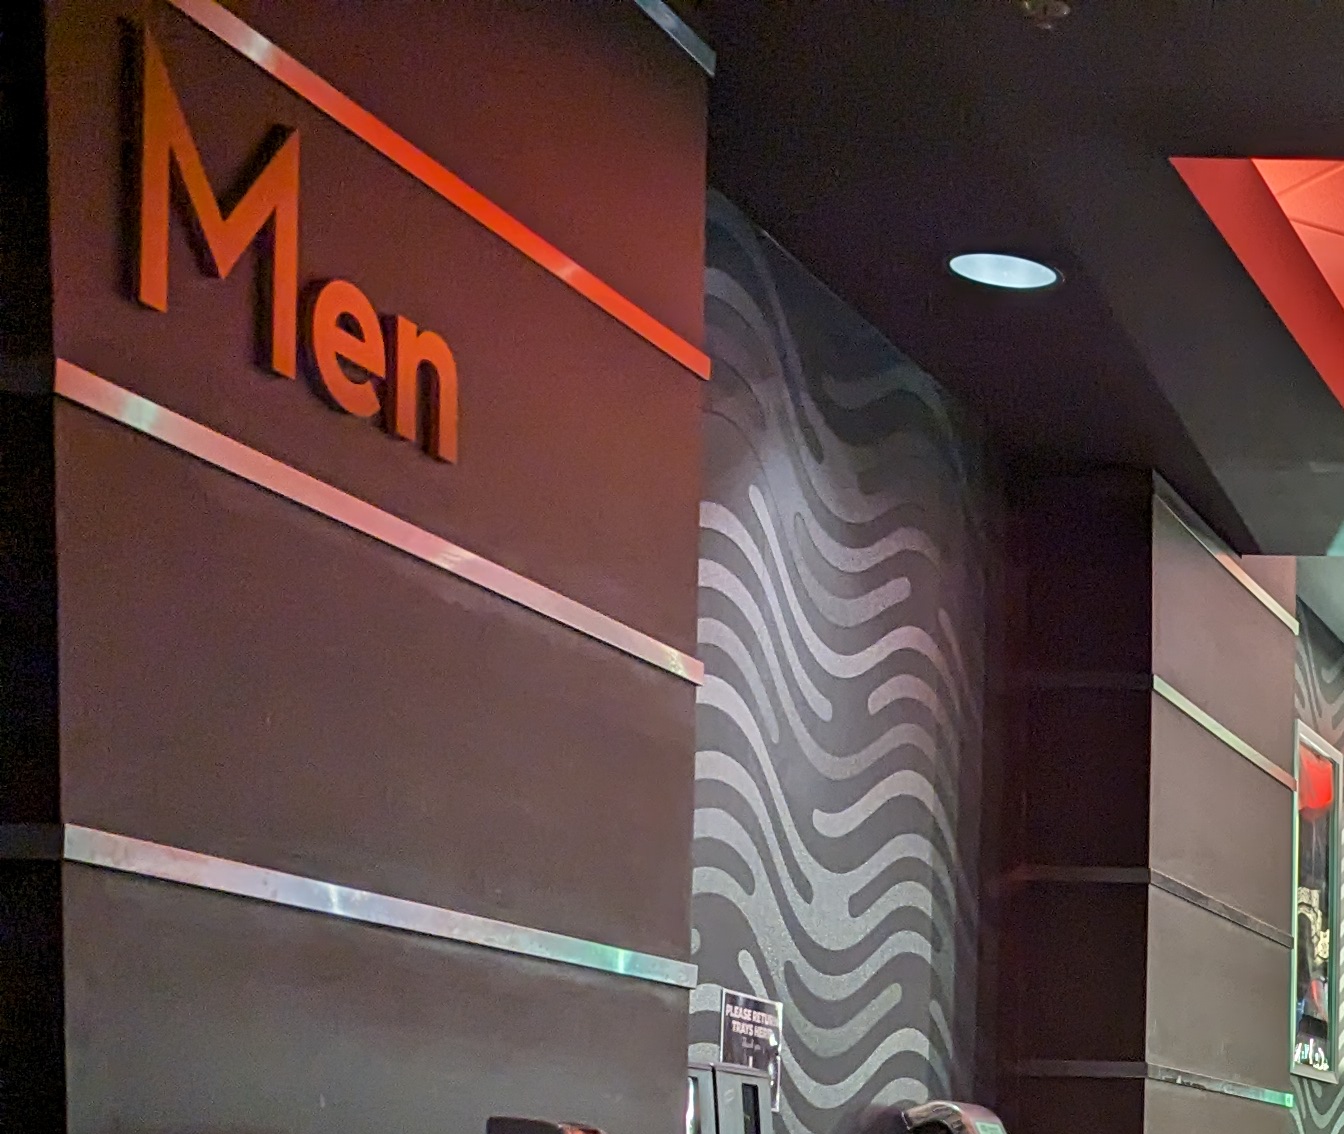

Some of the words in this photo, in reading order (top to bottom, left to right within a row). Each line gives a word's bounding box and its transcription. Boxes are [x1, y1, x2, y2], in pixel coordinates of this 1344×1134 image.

[139, 25, 458, 465] Men
[725, 1003, 752, 1021] PLEASE
[731, 1020, 754, 1036] TRAYS
